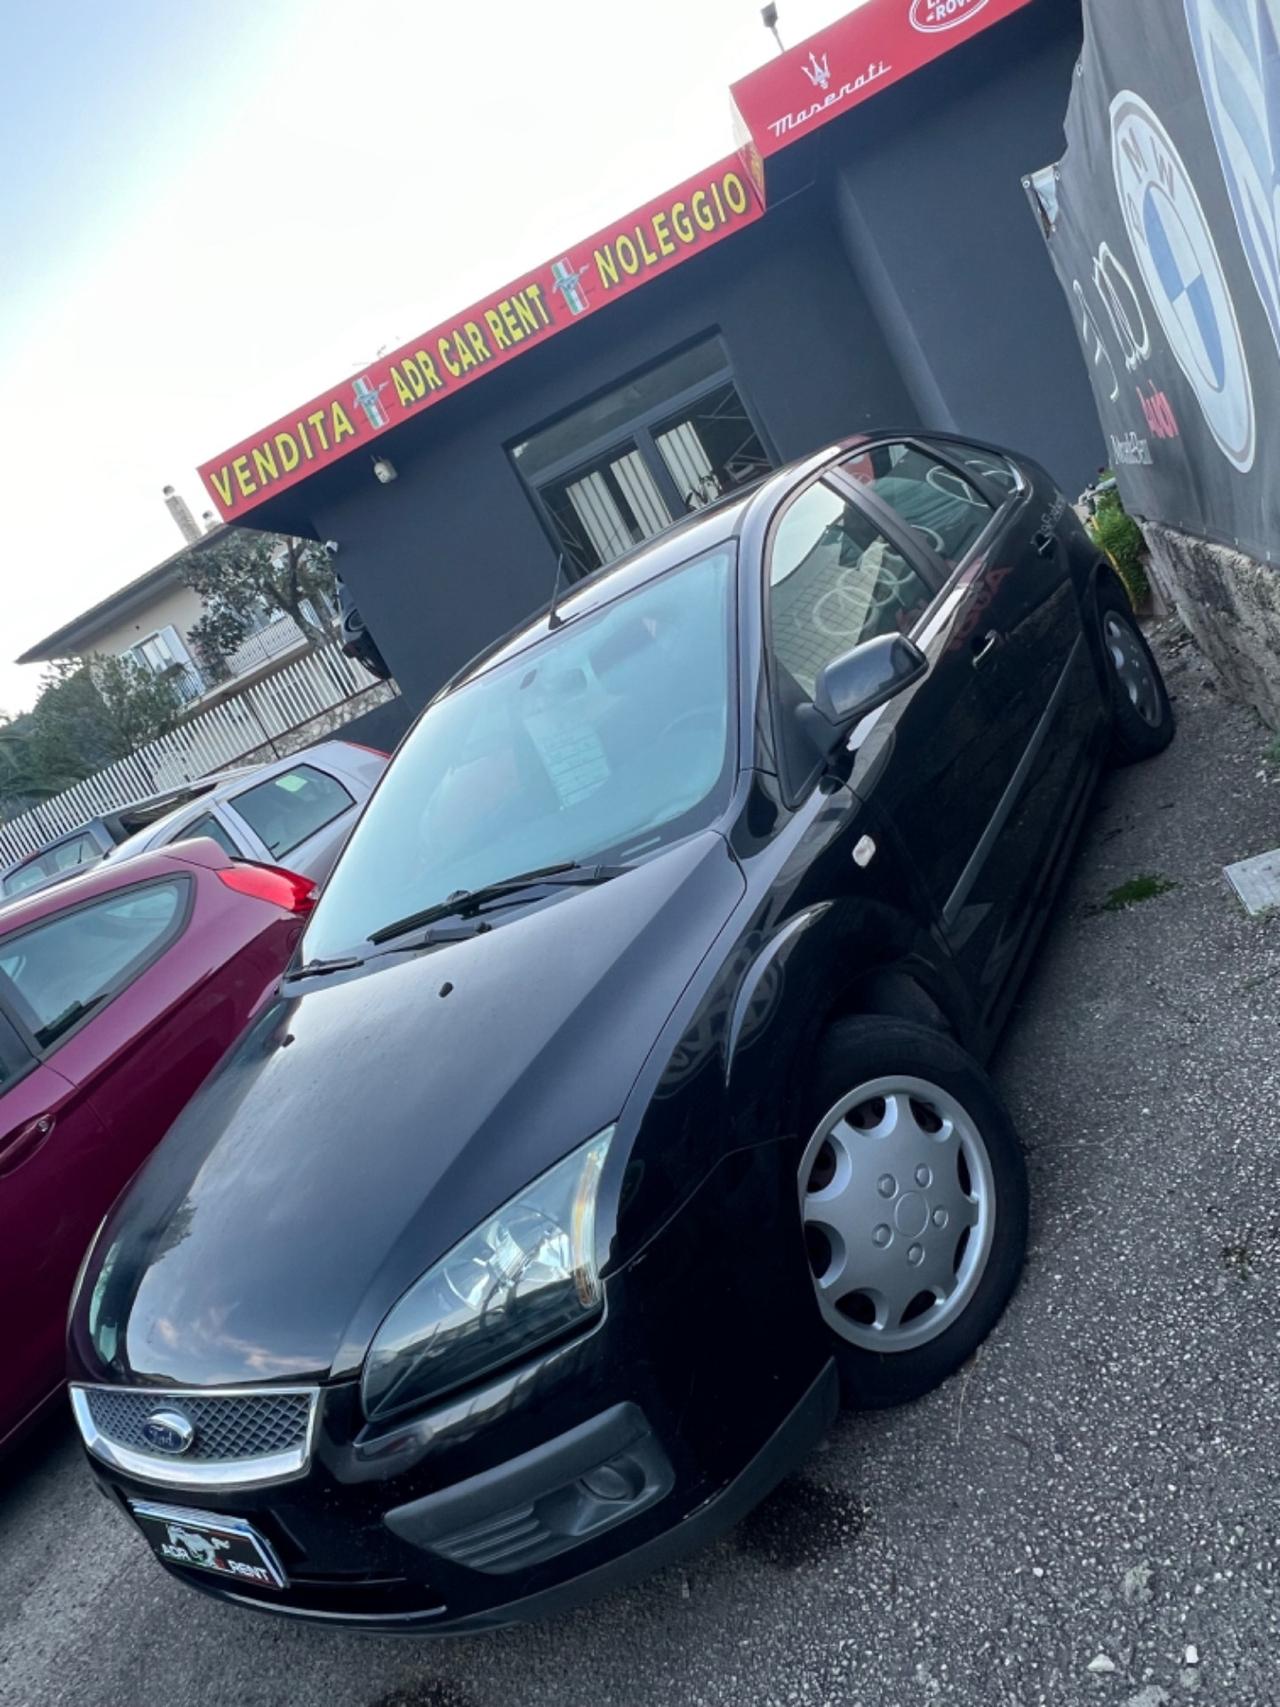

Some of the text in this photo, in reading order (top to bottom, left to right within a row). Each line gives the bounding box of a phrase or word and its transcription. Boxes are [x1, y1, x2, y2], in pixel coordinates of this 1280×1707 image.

[767, 61, 892, 137] Maserati
[1119, 127, 1176, 247] BMW
[210, 172, 748, 506] VENDITA ADR CAR RENT NOLEGGIO
[227, 1559, 270, 1581] RENT
